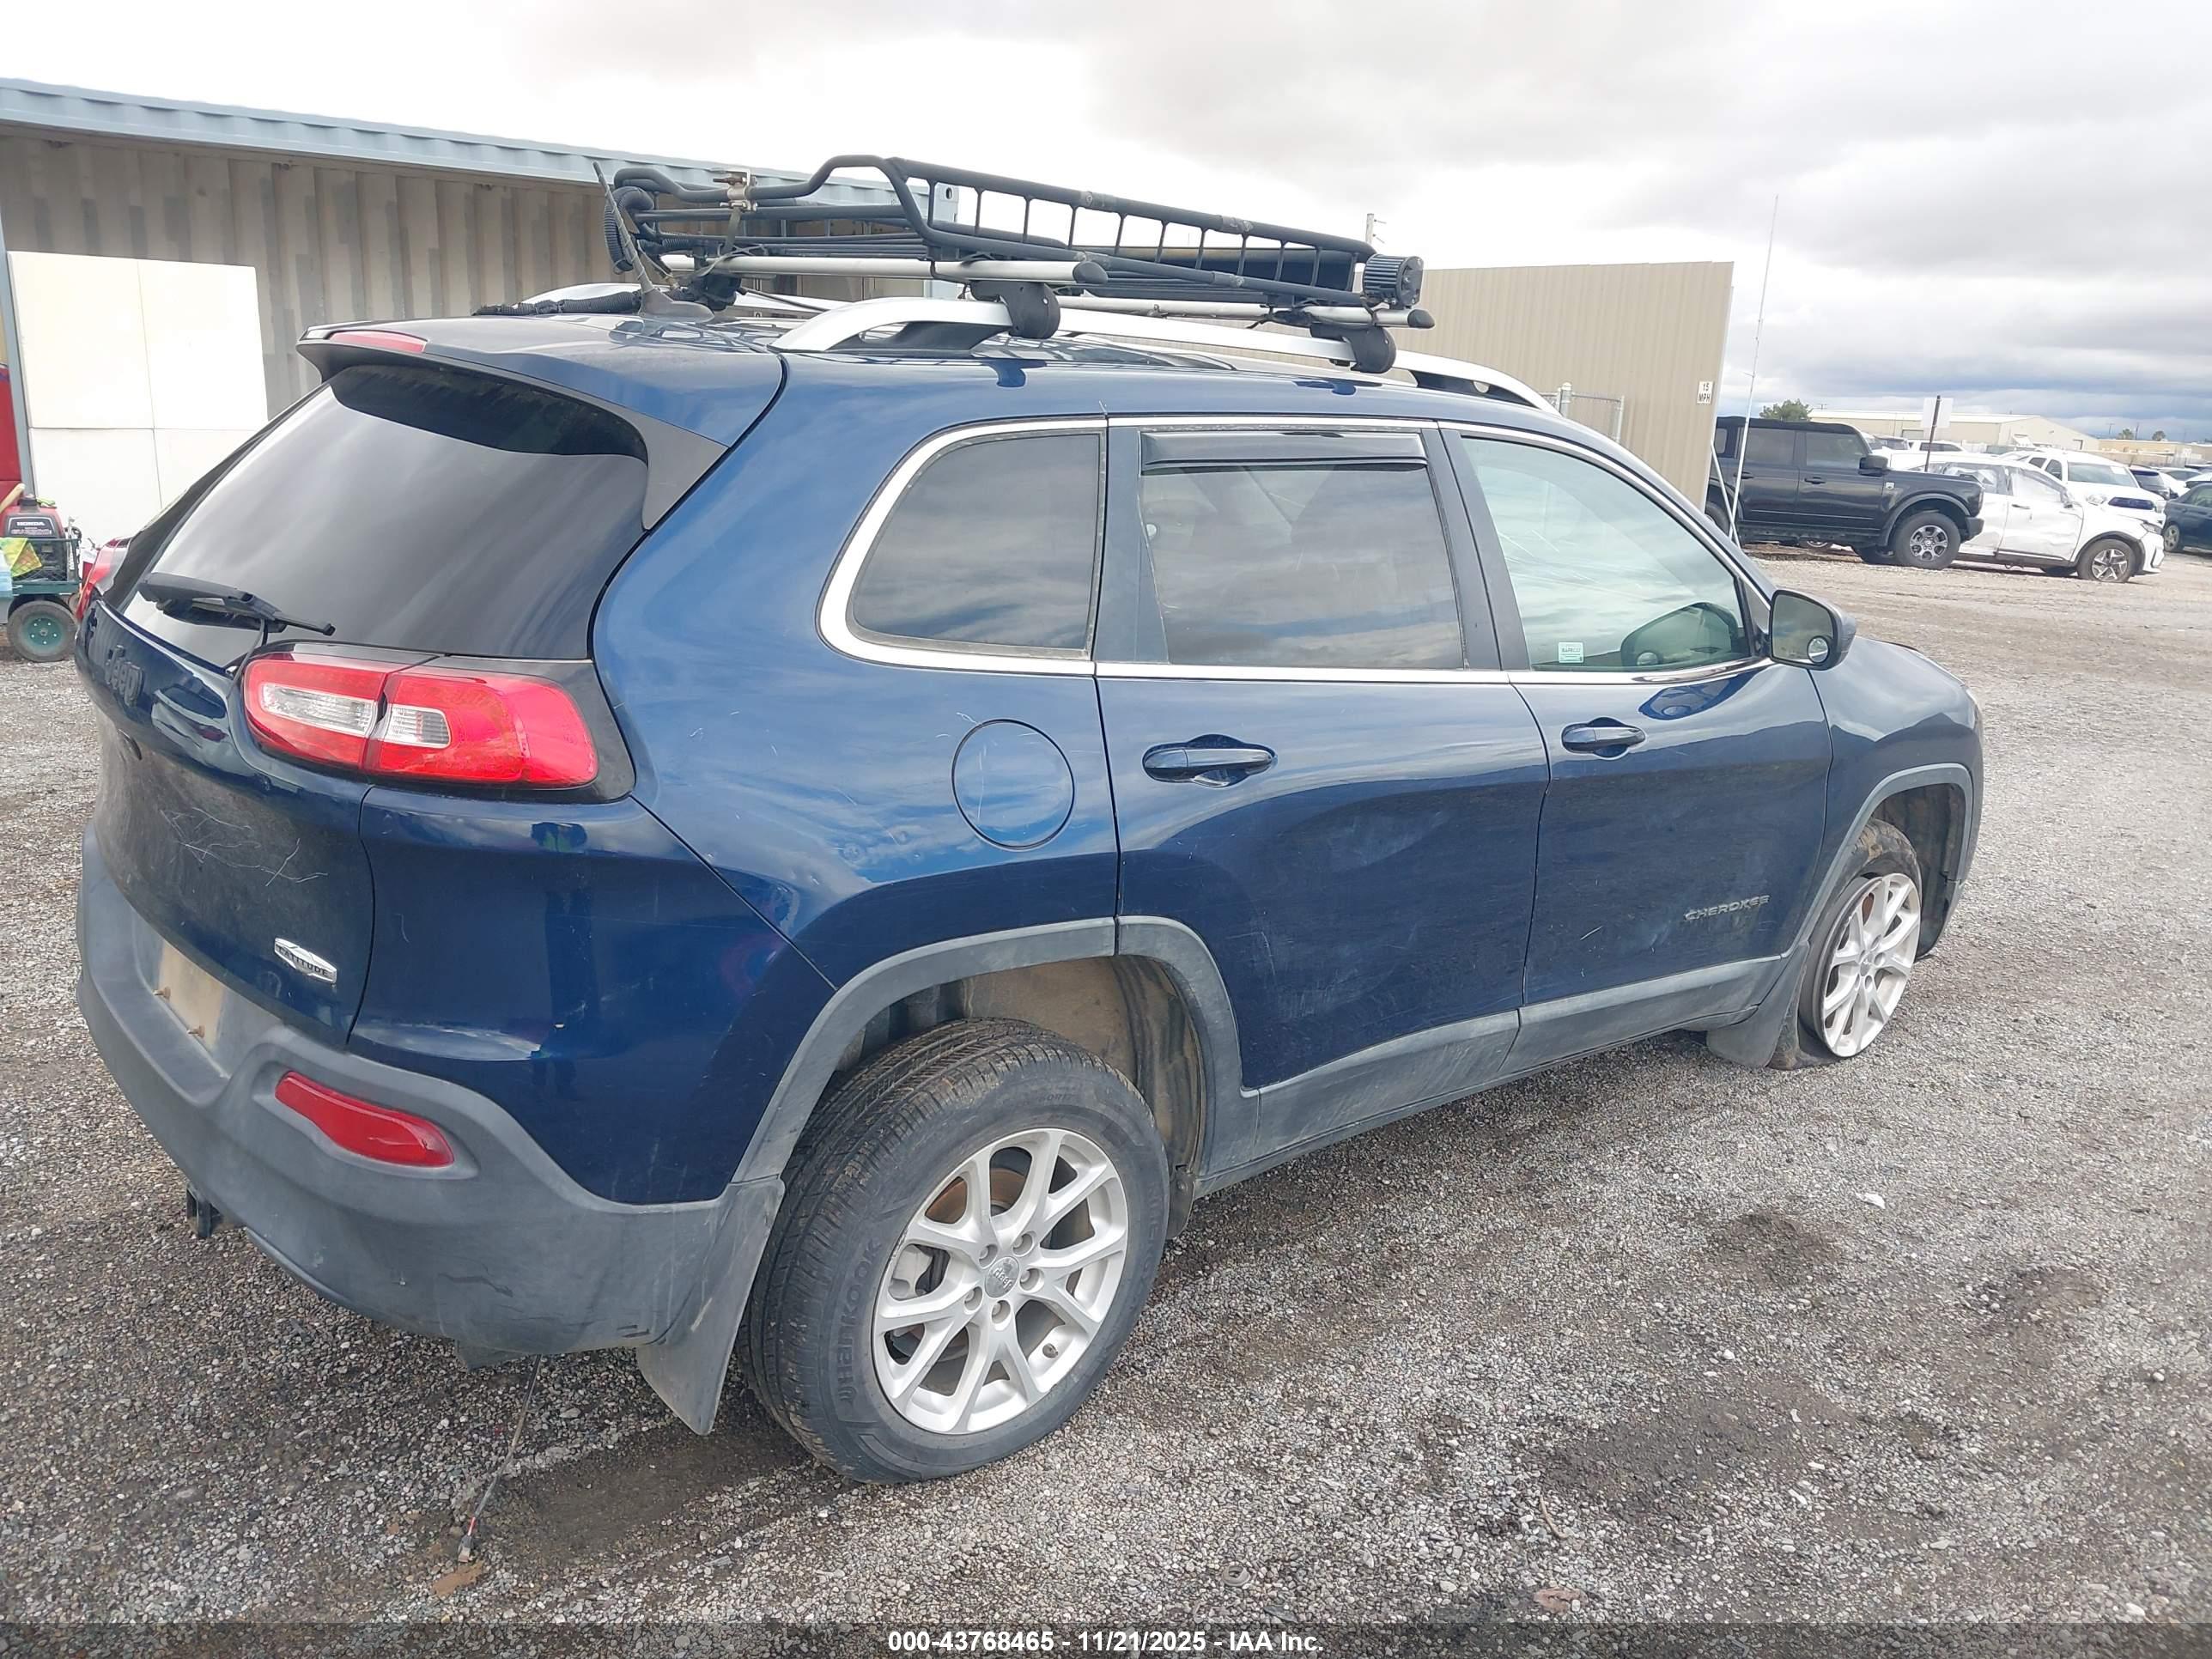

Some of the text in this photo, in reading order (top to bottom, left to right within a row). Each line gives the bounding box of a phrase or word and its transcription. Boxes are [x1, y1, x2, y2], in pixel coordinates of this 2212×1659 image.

[1698, 392, 1711, 402] MPH
[1703, 382, 1710, 392] 15
[105, 644, 143, 707] Jeep
[1684, 895, 1771, 921] CHEROKEE
[277, 945, 329, 977] LATITUDE
[993, 1267, 1013, 1289] Jeep
